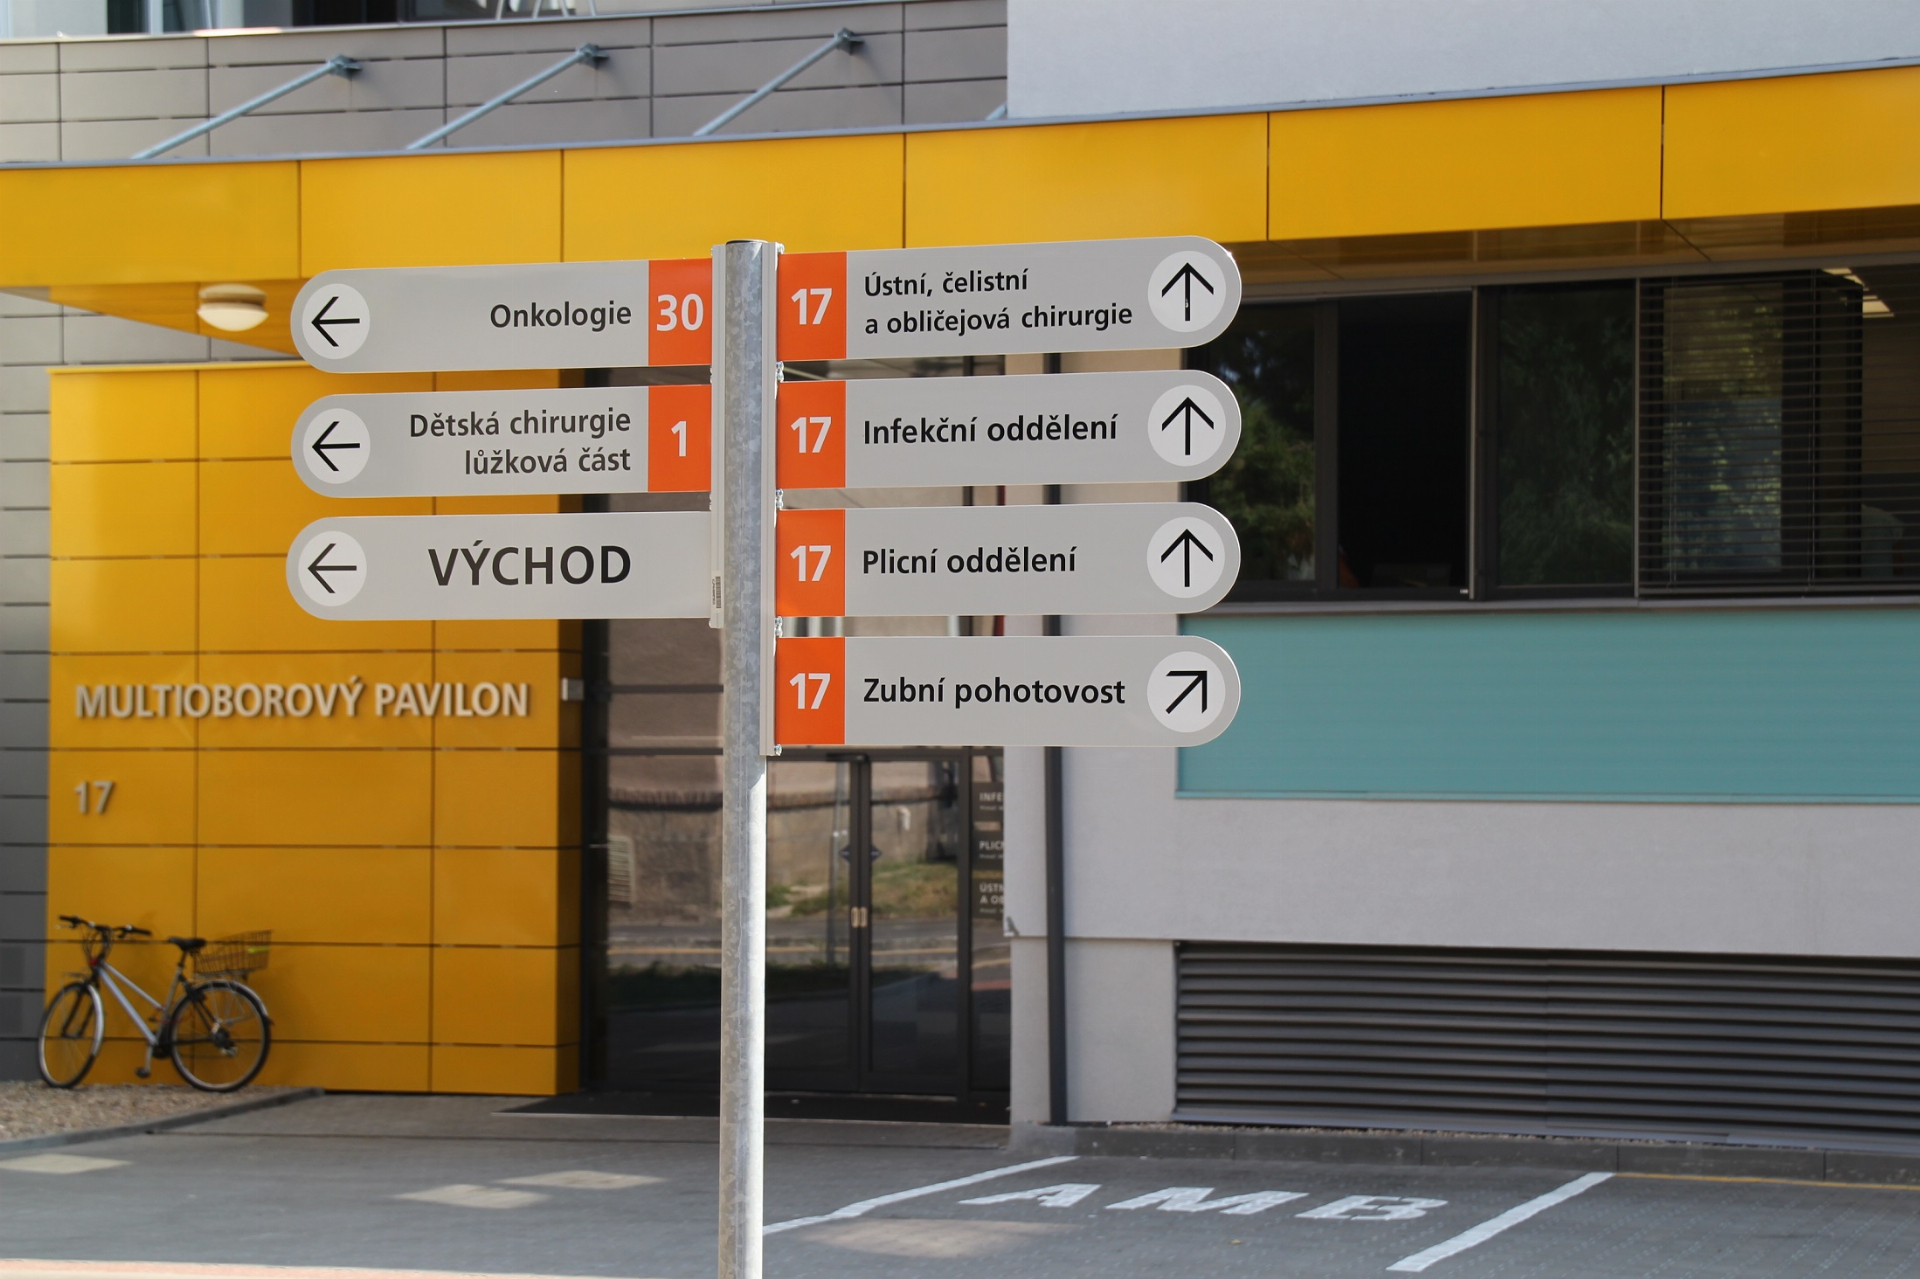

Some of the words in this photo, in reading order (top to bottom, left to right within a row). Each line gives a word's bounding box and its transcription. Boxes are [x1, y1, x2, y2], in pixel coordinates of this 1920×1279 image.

[864, 271, 933, 297] Ústní,
[942, 267, 1029, 294] čelistní
[490, 300, 632, 333] Onkologie
[656, 293, 704, 332] 30
[790, 287, 833, 325] 17
[865, 318, 878, 335] a
[887, 307, 1010, 337] obličejová
[1021, 302, 1133, 332] chirurgie
[410, 411, 500, 438] Dětská
[509, 406, 631, 439] chirurgie
[670, 420, 687, 457] 1
[790, 416, 832, 454] 17
[864, 416, 978, 445] Infekční
[987, 413, 1119, 442] oddělení
[465, 447, 567, 475] lůžková
[578, 446, 631, 472] část
[427, 539, 631, 586] VÝCHOD
[790, 544, 832, 582] 17
[863, 548, 938, 574] Plicní
[946, 546, 1077, 574] oddělení
[75, 676, 363, 719] MULTIOBOROVÝ
[374, 683, 529, 719] PAVILON
[789, 672, 831, 710] 17
[863, 676, 946, 703] Zubní
[955, 676, 1126, 709] pohotovost
[74, 781, 114, 815] 17
[979, 792, 1003, 802] INFE
[958, 1183, 1449, 1221] AMB
